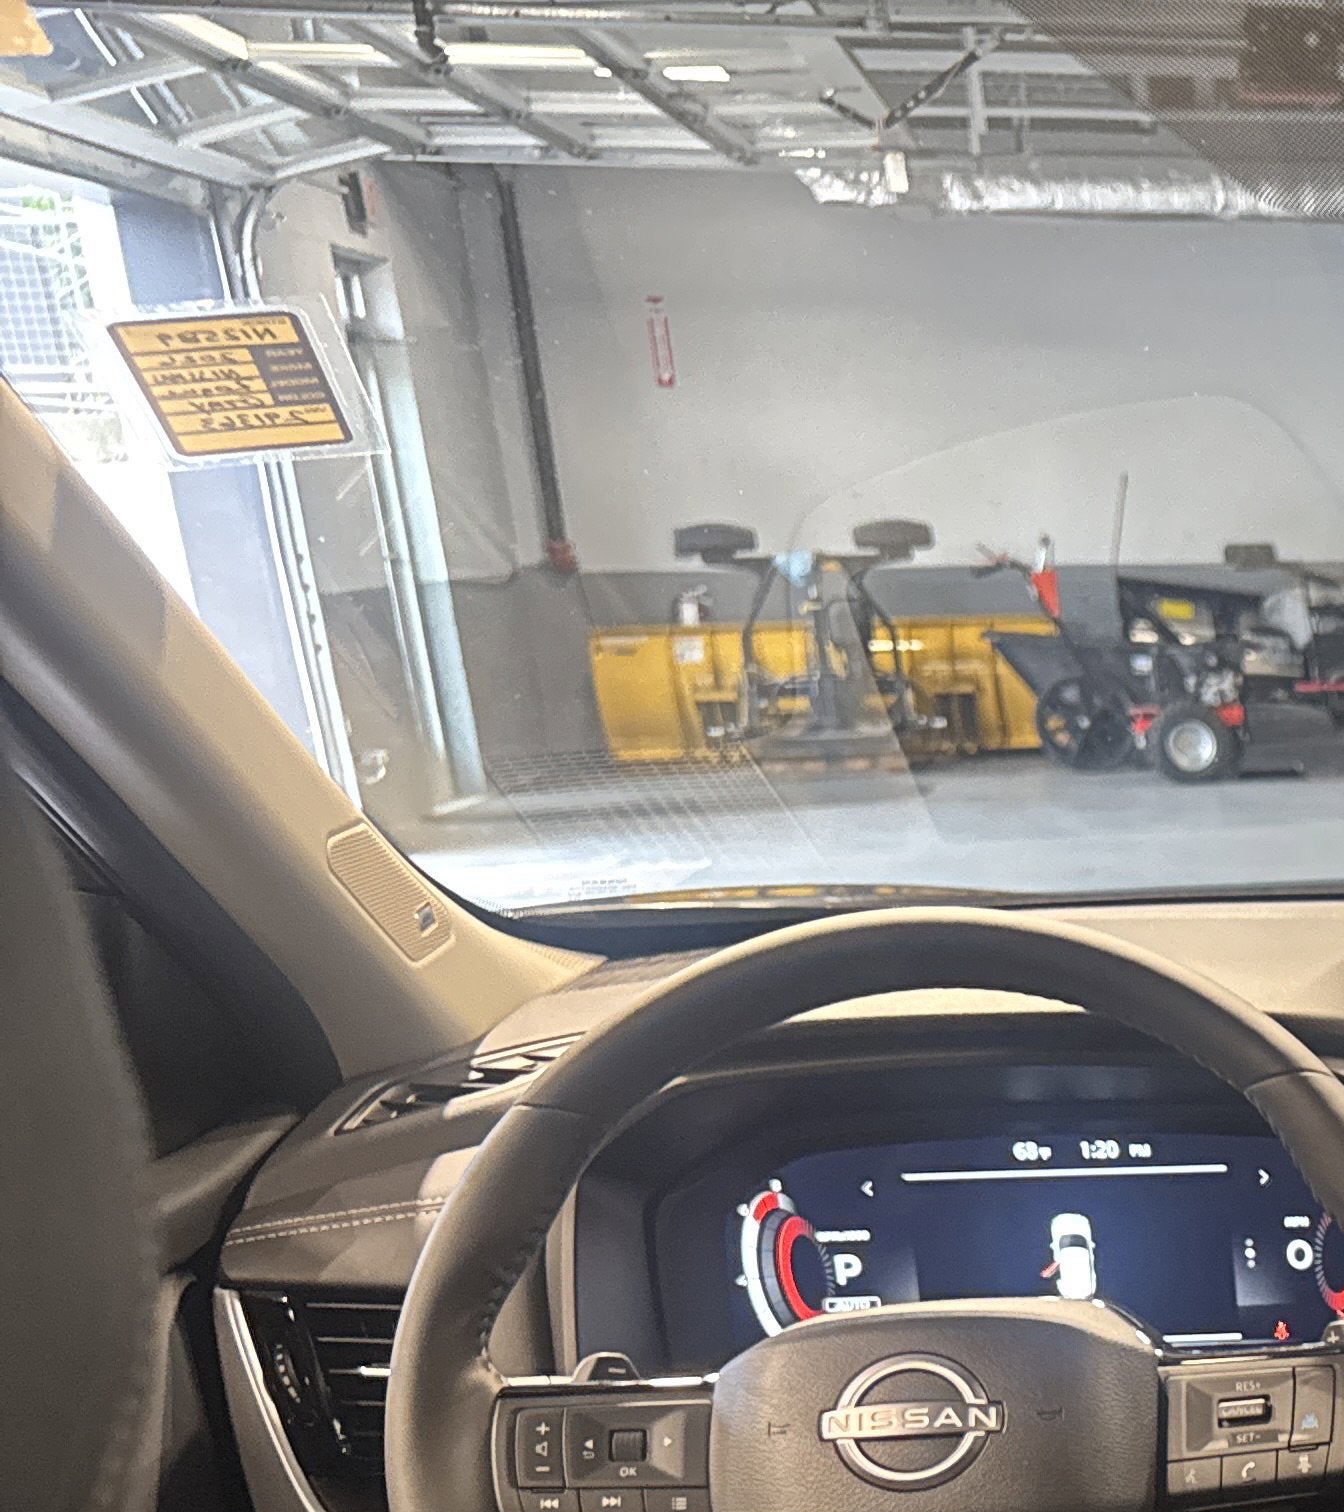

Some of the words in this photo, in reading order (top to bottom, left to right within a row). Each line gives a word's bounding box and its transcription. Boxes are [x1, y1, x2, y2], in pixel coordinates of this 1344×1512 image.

[1079, 1139, 1120, 1160] 1:20
[833, 1253, 863, 1286] P
[828, 1406, 998, 1434] NISSAN
[619, 1466, 638, 1477] OK
